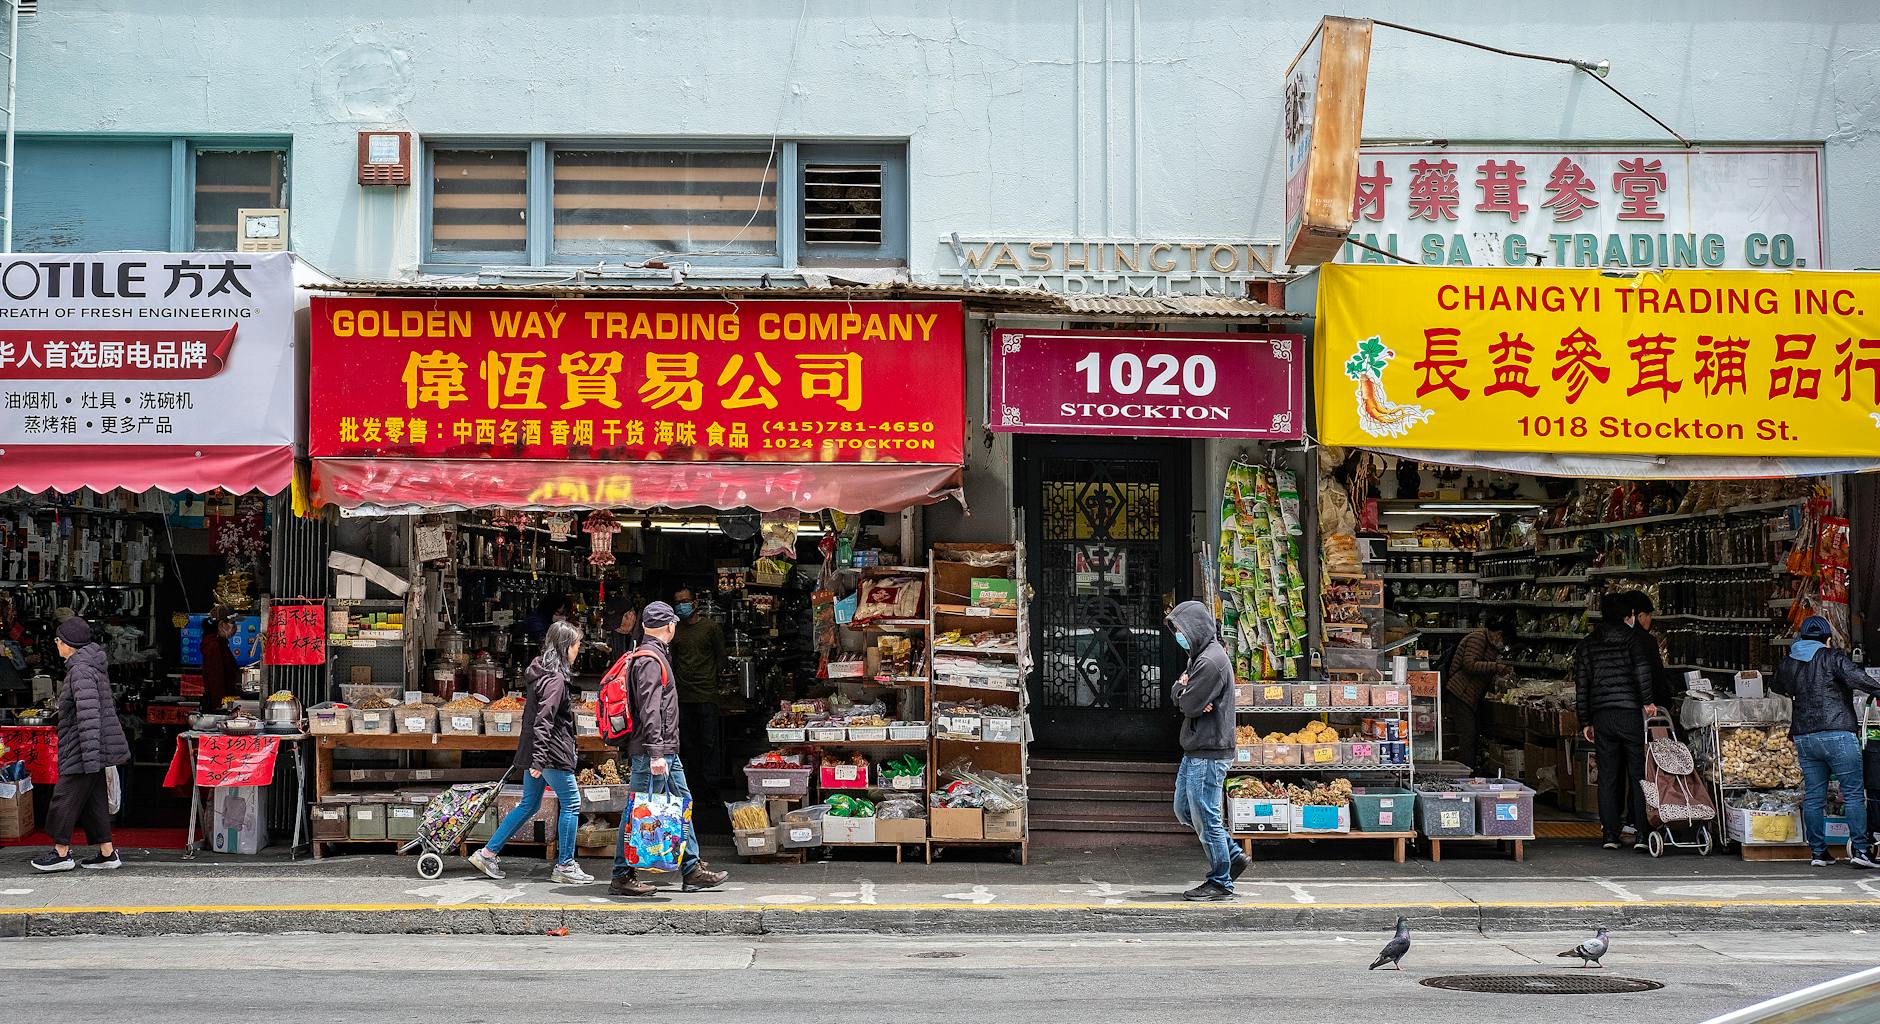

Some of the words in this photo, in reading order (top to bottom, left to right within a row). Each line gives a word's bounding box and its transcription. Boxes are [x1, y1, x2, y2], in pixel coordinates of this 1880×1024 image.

[950, 242, 1273, 274] WASHINGTON
[1421, 233, 1528, 266] SAG
[1549, 233, 1726, 266] TRADING
[1745, 233, 1806, 267] CO.
[0, 261, 147, 300] OTILE
[163, 260, 252, 299] 方太
[54, 308, 75, 318] OF
[81, 308, 133, 318] FRESH
[1437, 284, 1600, 313] CHANGYI
[1614, 287, 1778, 314] TRADING
[1794, 289, 1864, 316] INC.
[333, 310, 472, 338] GOLDEN
[490, 311, 567, 339] WAY
[584, 312, 740, 340] TRADING
[759, 313, 938, 341] COMPANY
[401, 349, 864, 412] 偉恆貿易公司
[1075, 352, 1216, 397] 1020
[4, 391, 58, 410] 油烟机
[81, 391, 117, 410] 灶具
[139, 391, 193, 410] 洗碗机
[1060, 403, 1231, 420] STOCKTON
[24, 415, 78, 434] 蒸烤箱
[100, 415, 173, 434] 更多产品
[550, 419, 593, 446] 香烟
[601, 419, 645, 446] 干货
[653, 420, 697, 447] 海味
[705, 421, 749, 448] 食品
[762, 420, 935, 433] (415)781-4650
[1518, 416, 1588, 438] 1018
[1599, 416, 1744, 440] Stockton
[1756, 418, 1798, 441] St.
[762, 438, 814, 449] 1024
[821, 438, 935, 449] STOCKTON
